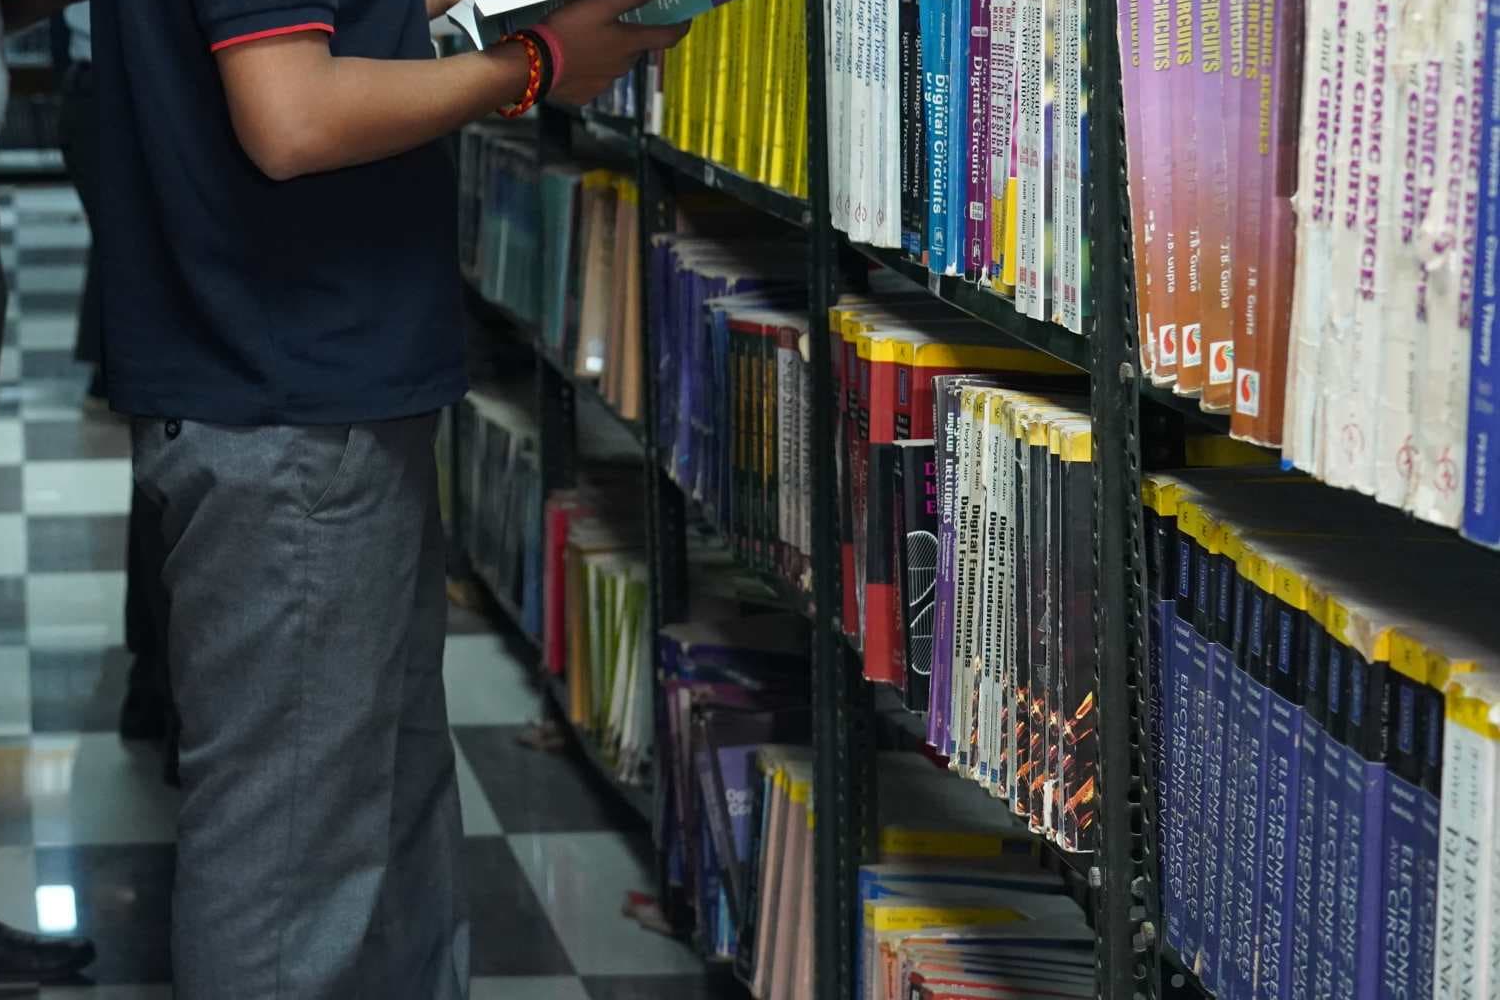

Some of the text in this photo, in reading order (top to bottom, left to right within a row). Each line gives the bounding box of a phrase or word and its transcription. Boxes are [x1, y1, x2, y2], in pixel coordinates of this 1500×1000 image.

[931, 74, 946, 215] Digital Circuits
[971, 55, 985, 184] Digital Circuits
[1312, 76, 1331, 224] CIRCUITS
[1345, 81, 1366, 230] CIRCUITS
[1402, 91, 1420, 245] CIRCUITS
[1218, 269, 1230, 309] Gupta
[1359, 174, 1381, 302] DEVICES
[955, 495, 970, 658] Digital Fundamentals
[964, 504, 981, 669] Digital Fundamentals
[983, 511, 997, 678] Digital Fundamentals
[998, 515, 1008, 565] Digital
[1174, 672, 1189, 901] ELECTRONIC DEVICES
[1265, 799, 1278, 894] CIRCUIT
[1274, 754, 1289, 905] ELECTRONIC
[1384, 888, 1401, 991] CIRCUIT
